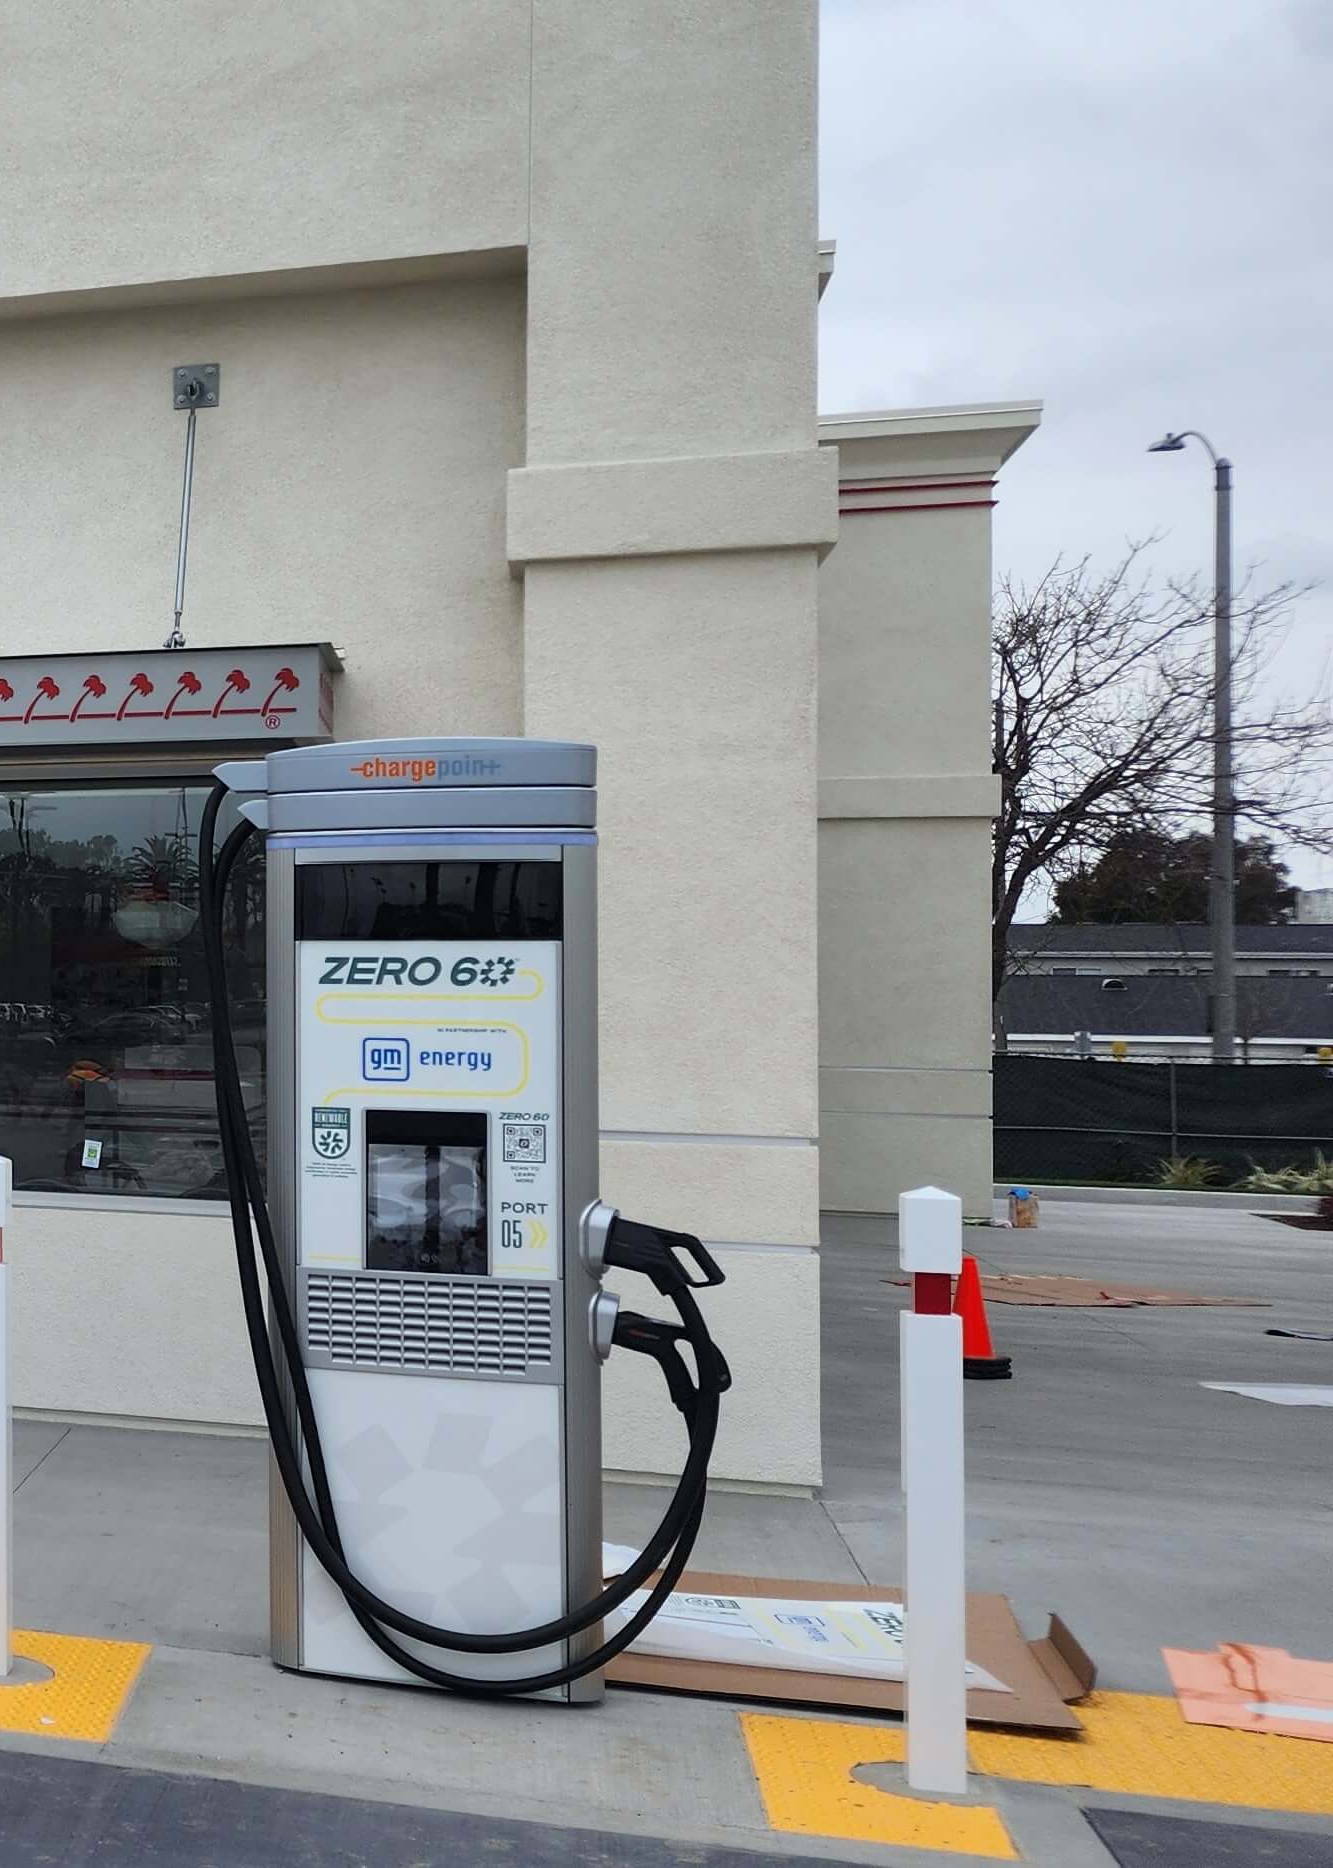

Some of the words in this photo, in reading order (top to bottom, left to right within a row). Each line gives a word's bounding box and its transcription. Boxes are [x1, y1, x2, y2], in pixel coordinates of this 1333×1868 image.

[318, 956, 442, 986] ZERO
[370, 1048, 401, 1070] gm
[420, 1050, 492, 1071] energy
[499, 1112, 532, 1121] ZERO
[501, 1201, 549, 1215] PORT
[501, 1219, 523, 1249] 05
